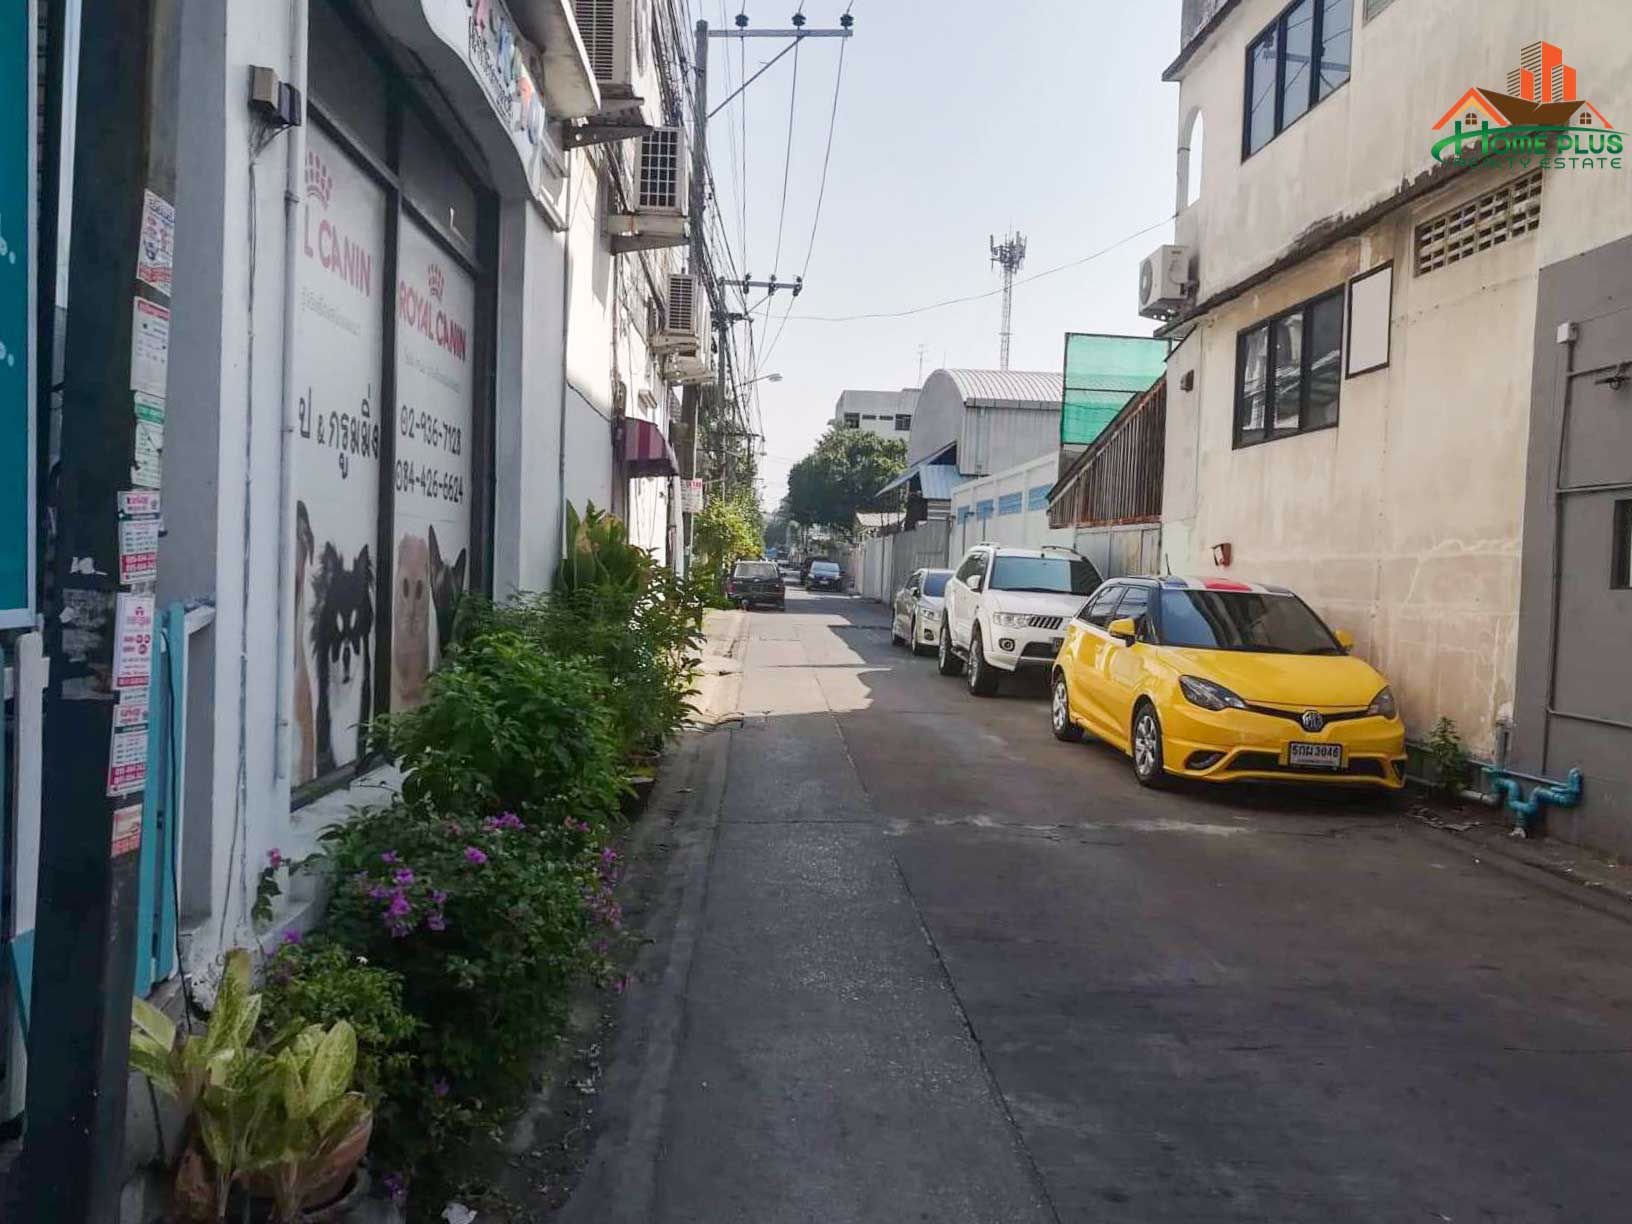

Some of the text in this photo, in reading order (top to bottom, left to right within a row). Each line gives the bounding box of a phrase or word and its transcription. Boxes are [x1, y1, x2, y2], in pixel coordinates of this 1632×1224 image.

[318, 219, 371, 298] CANIN
[400, 280, 434, 341] ROYAL
[435, 310, 467, 363] CANIN
[400, 405, 462, 456] 02-936-7128
[395, 459, 464, 504] 084-426-6624
